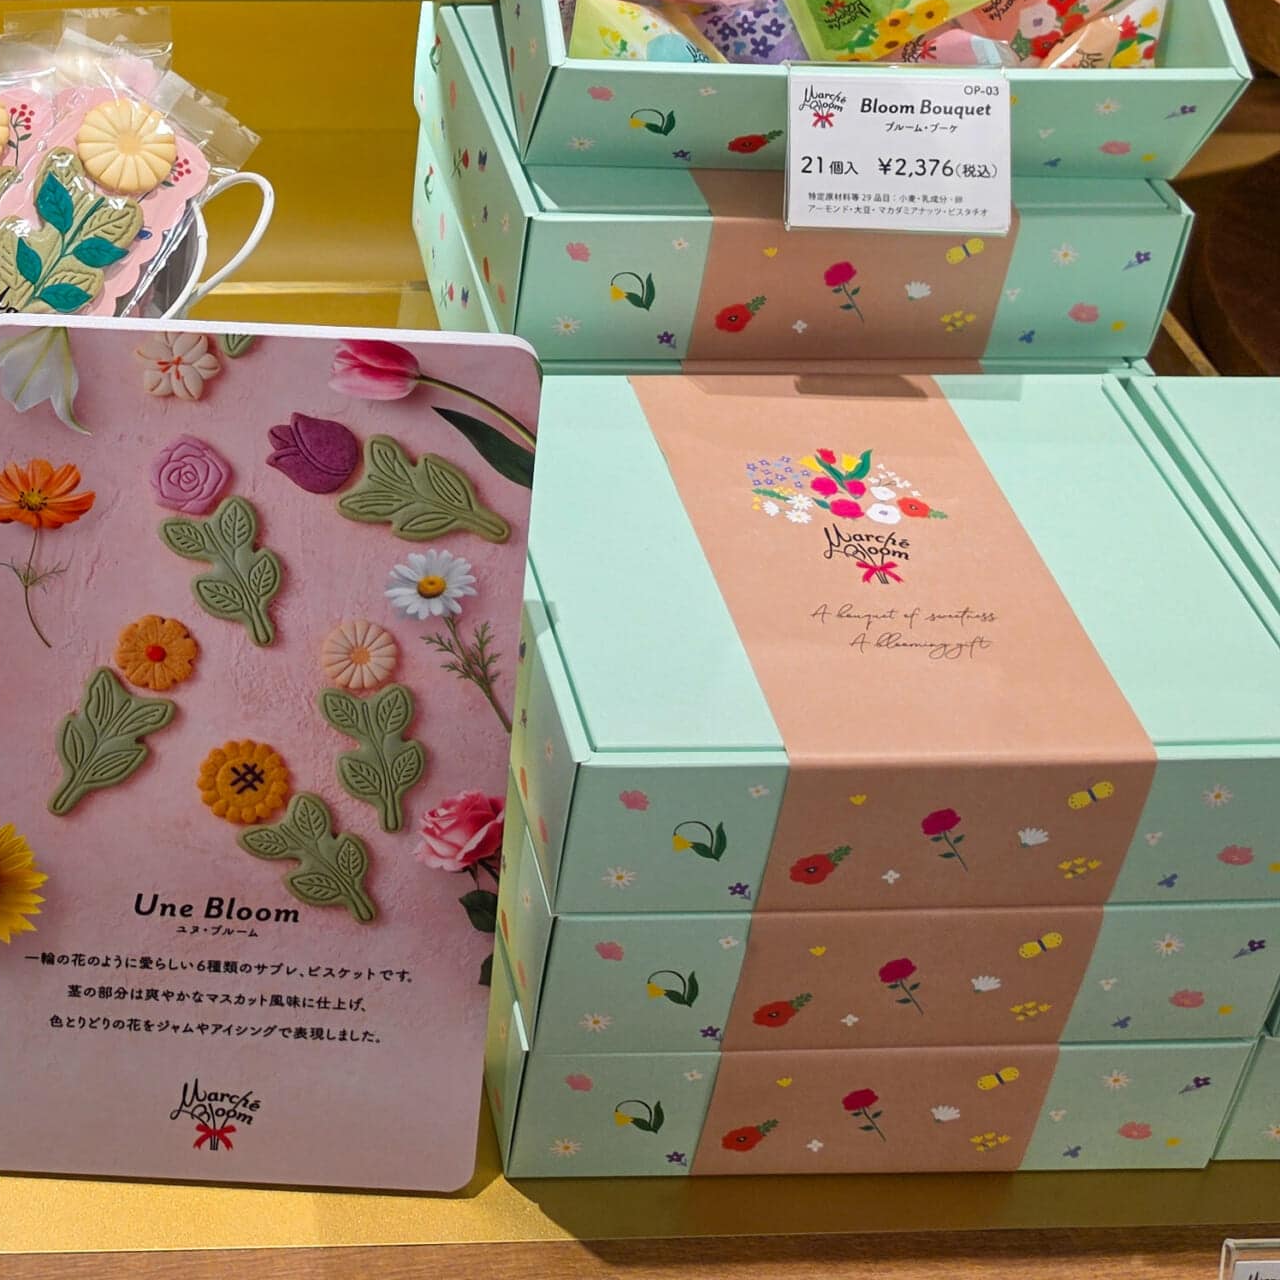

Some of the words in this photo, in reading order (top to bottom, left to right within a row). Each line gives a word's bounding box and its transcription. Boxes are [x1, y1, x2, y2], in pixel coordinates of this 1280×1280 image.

[963, 85, 1000, 96] OP-03
[860, 98, 915, 115] Bloom
[919, 99, 992, 119] Bouquet
[884, 121, 959, 133] ブルーム・ブーケ
[801, 156, 859, 176] 21個入
[824, 523, 910, 560] Marché
[843, 543, 909, 566] Bloom
[809, 604, 833, 624] A
[836, 603, 897, 631] bouquet
[903, 604, 921, 629] of
[925, 605, 999, 627] sweetness
[849, 632, 872, 654] A
[134, 893, 194, 919] Une
[204, 895, 301, 923] Bloom
[176, 925, 259, 938] ユヌ・ブルーム
[67, 984, 367, 1012] 茎の部分は爽やかなマスカット風味に仕上げ、
[49, 1014, 381, 1044] 色とりどりの花をジャムやアイシングで表現しました。
[169, 1078, 261, 1120] Marché
[190, 1103, 254, 1130] Bloom
